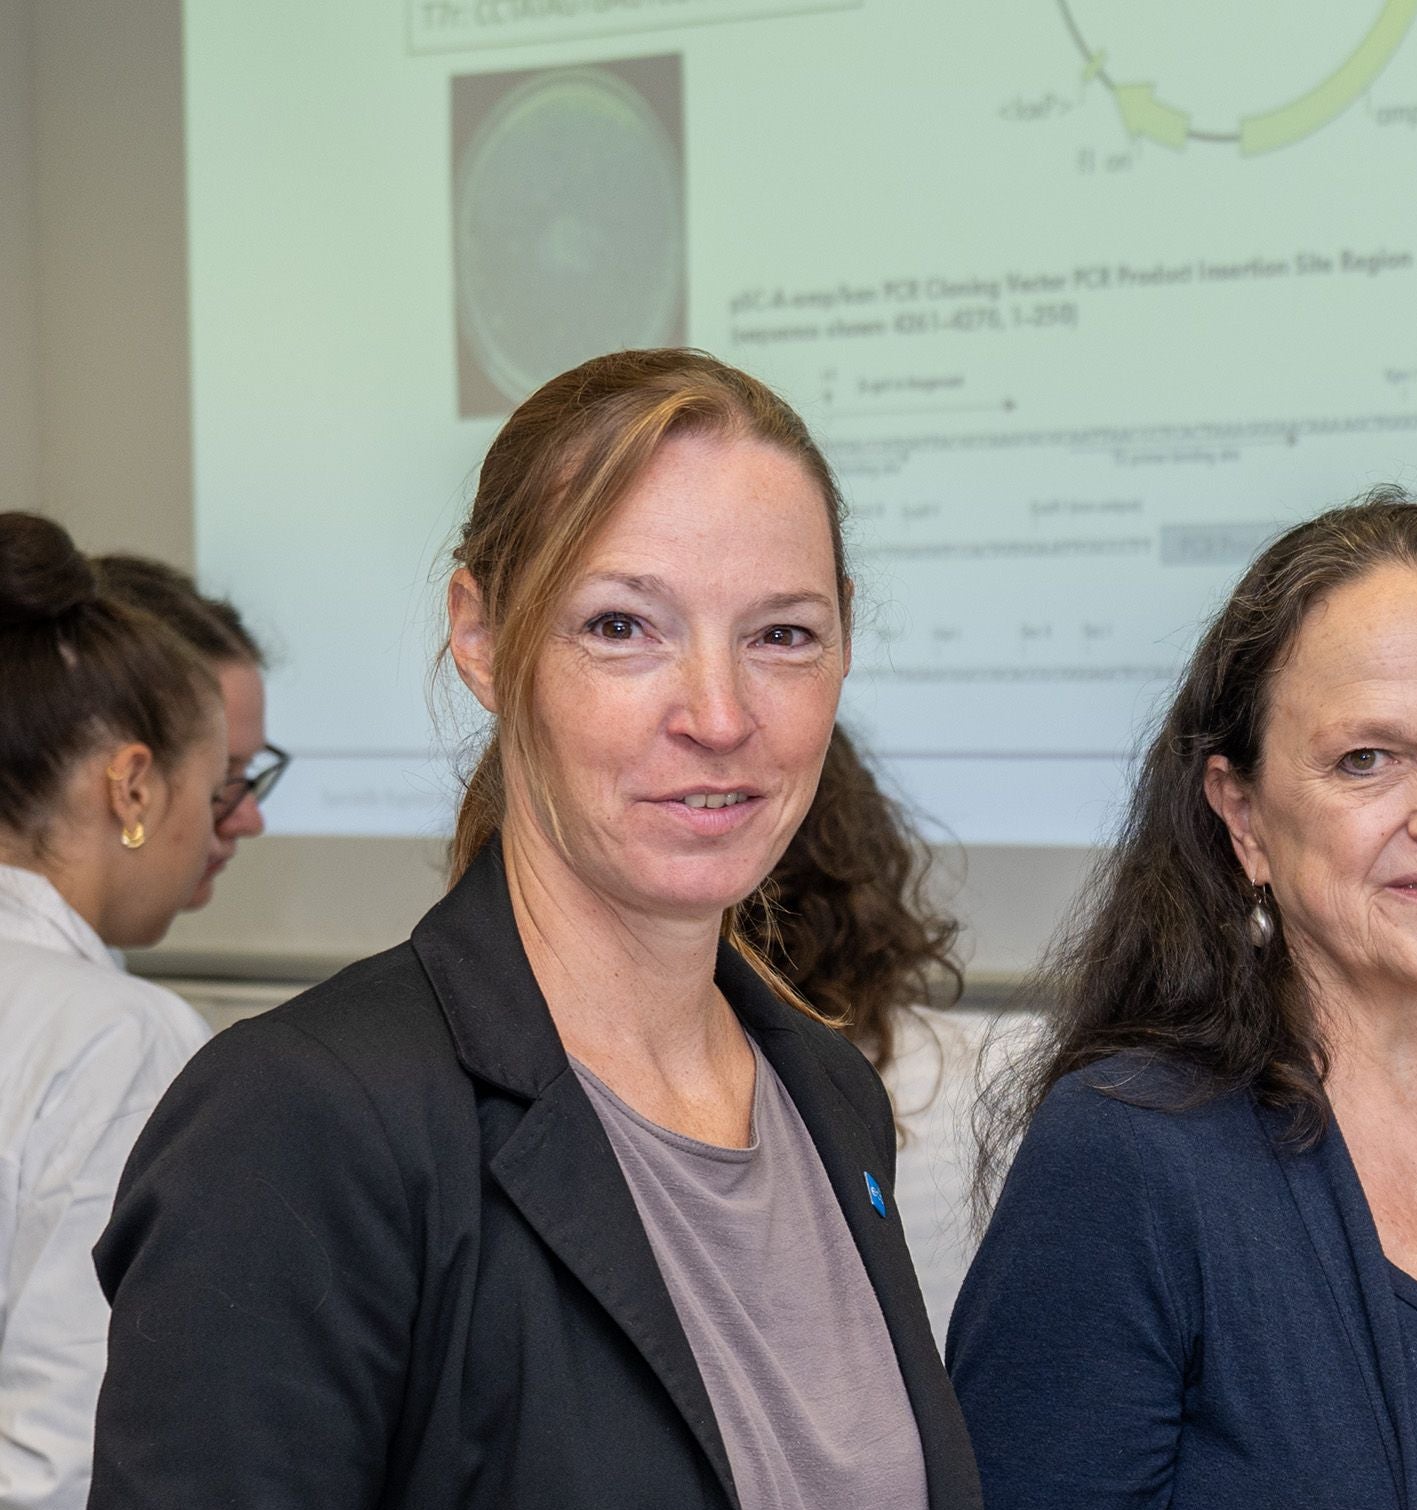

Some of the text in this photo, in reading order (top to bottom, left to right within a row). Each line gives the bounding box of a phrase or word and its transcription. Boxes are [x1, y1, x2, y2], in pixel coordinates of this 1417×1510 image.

[884, 278, 919, 301] PCR
[926, 274, 999, 301] Cloning
[1073, 264, 1110, 290] PCR
[1199, 256, 1289, 283] Insertion
[1340, 248, 1414, 278] Region
